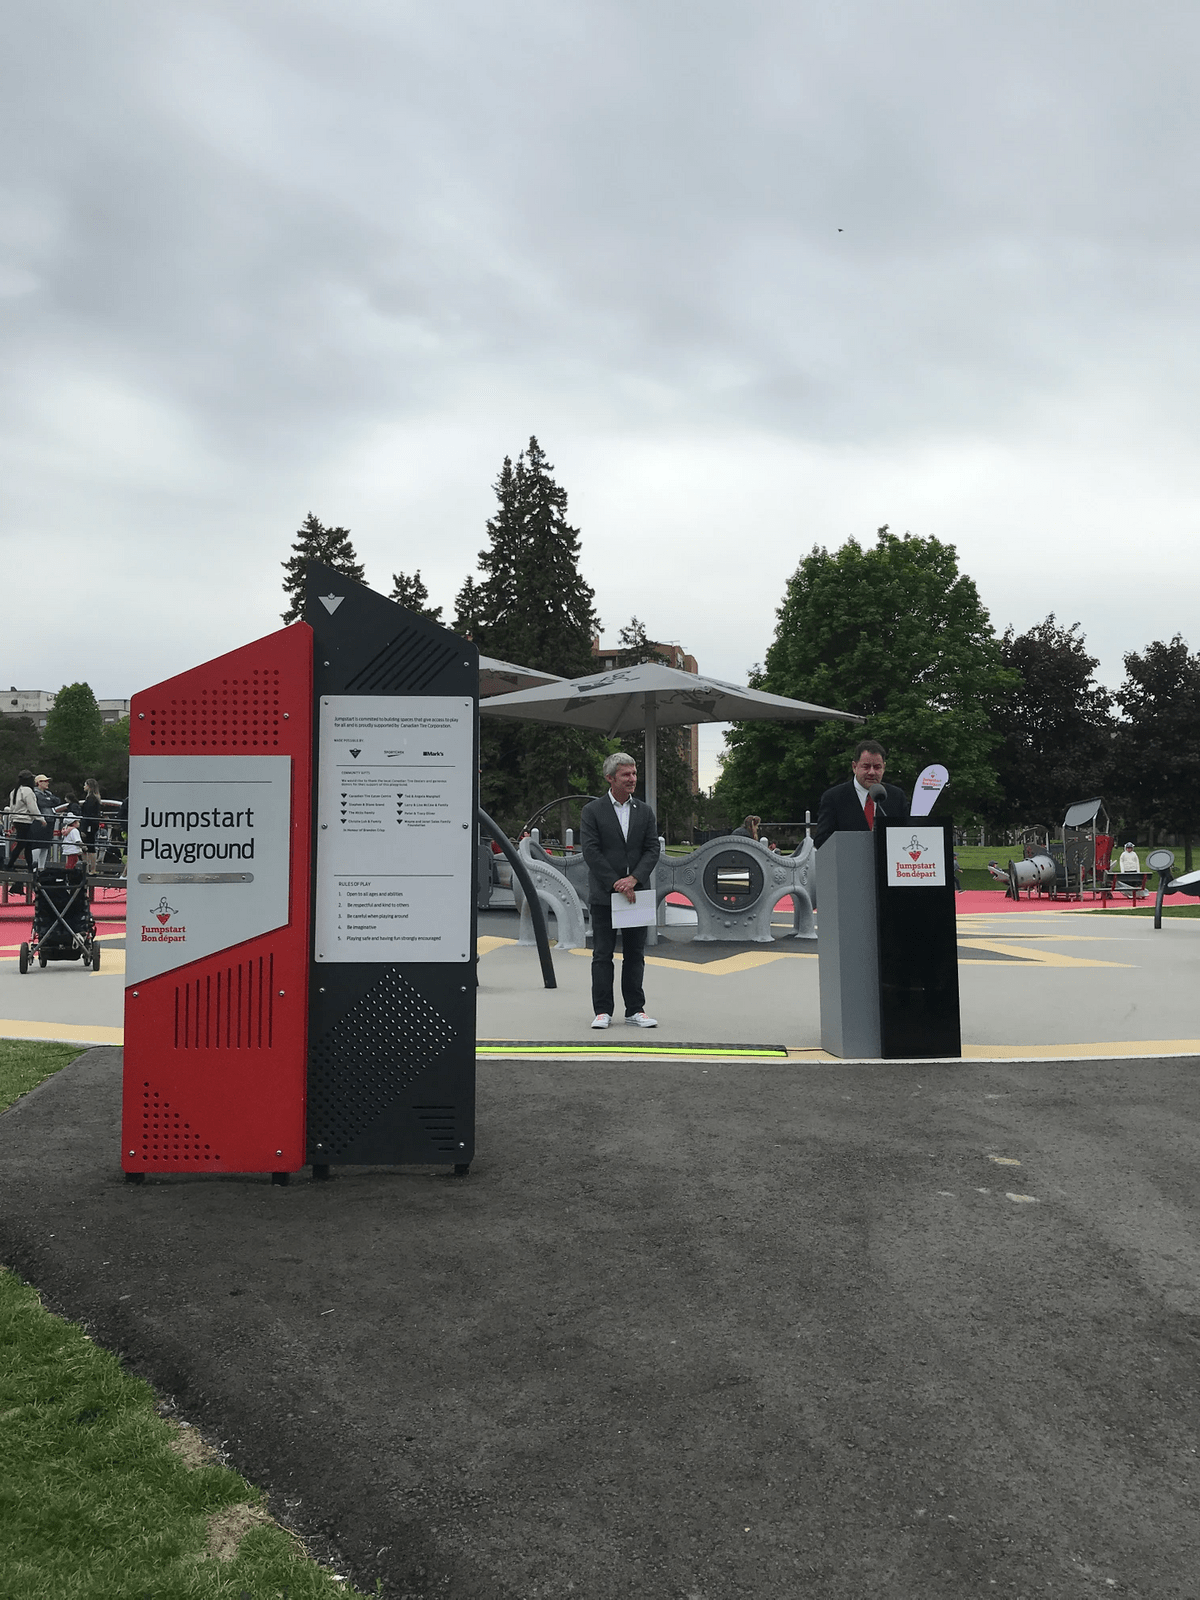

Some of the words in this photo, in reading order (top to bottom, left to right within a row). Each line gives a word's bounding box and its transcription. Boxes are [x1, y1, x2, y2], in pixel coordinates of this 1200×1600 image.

[140, 806, 254, 832] Jumpstart
[140, 838, 254, 864] Playground
[896, 862, 936, 871] Jumpstart
[141, 925, 186, 936] Jumpstart
